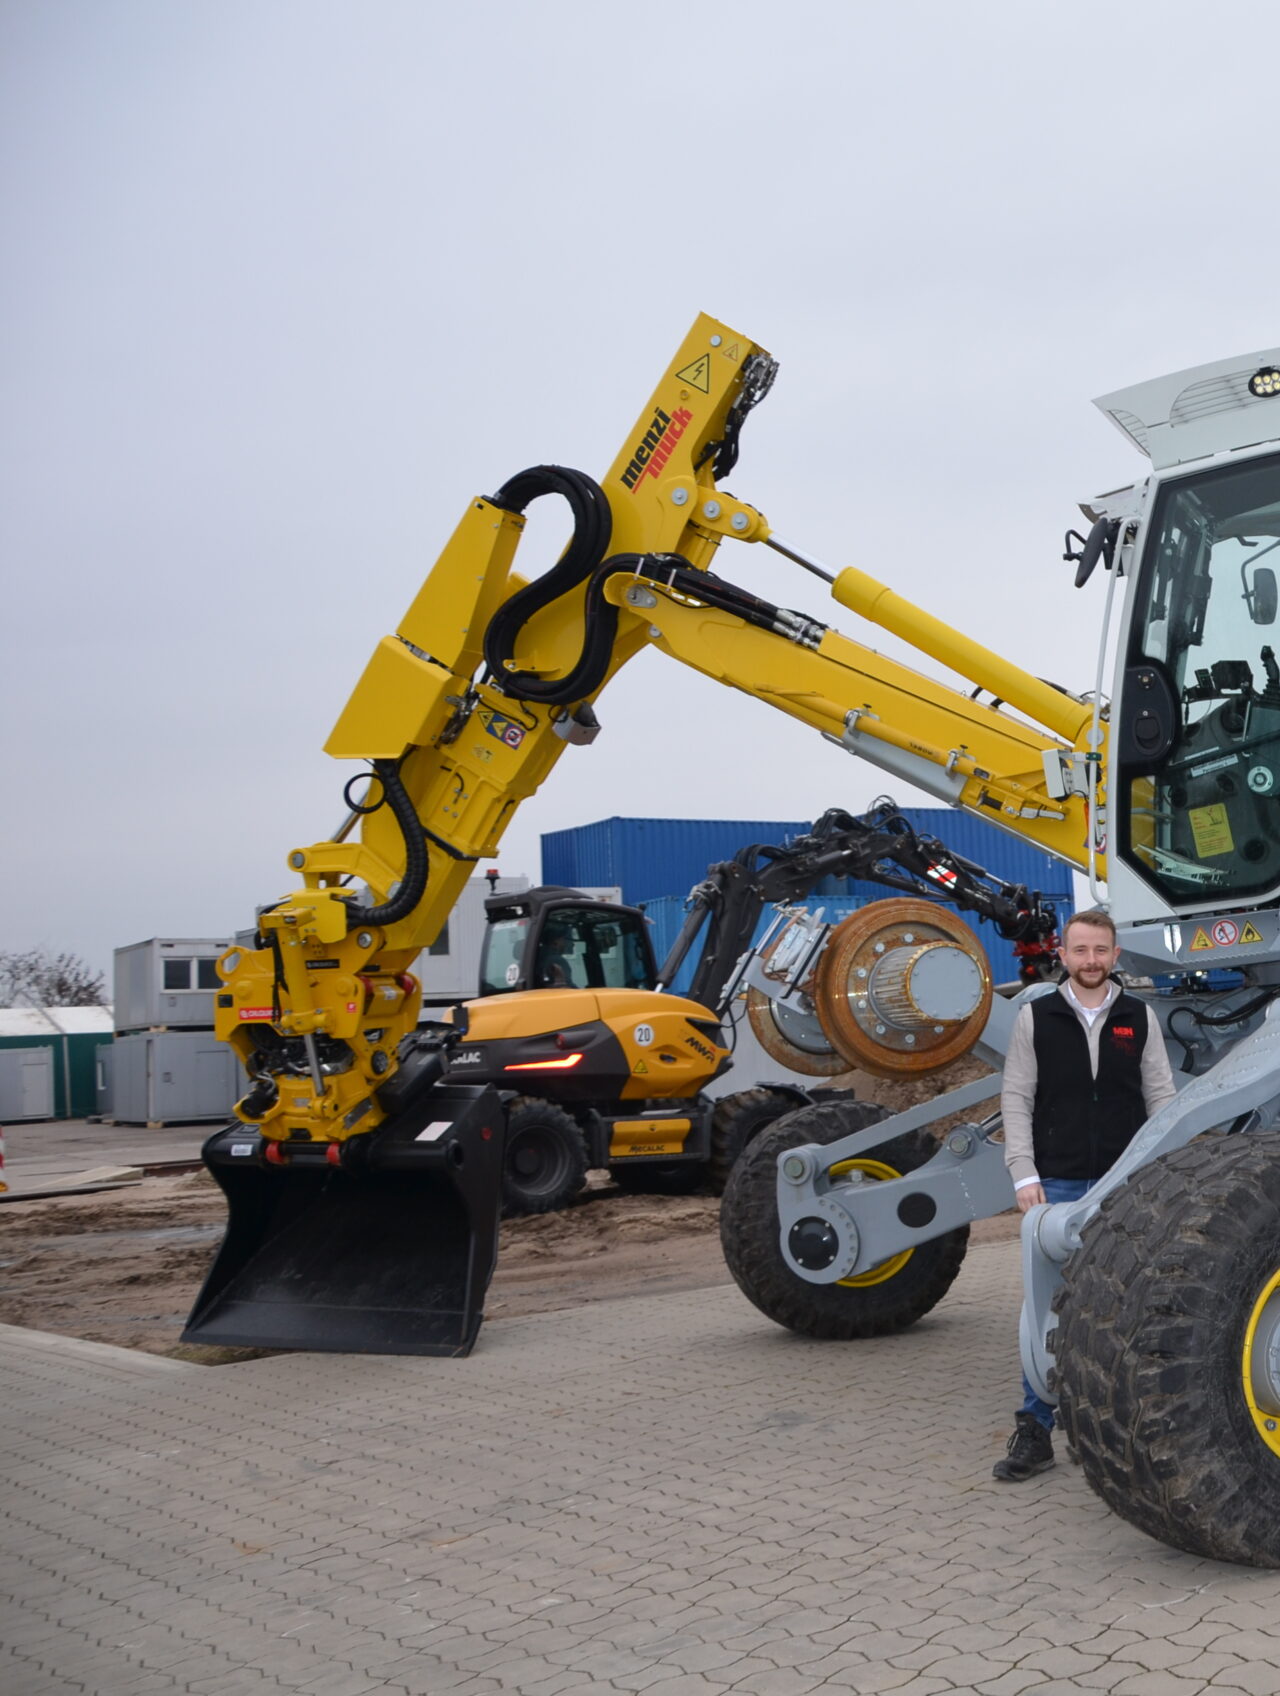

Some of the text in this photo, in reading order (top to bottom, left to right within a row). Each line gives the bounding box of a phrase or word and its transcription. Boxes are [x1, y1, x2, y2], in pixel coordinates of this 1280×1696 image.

[620, 406, 672, 489] menzi
[632, 405, 693, 494] muck
[507, 967, 517, 981] 20
[637, 1027, 651, 1042] 20
